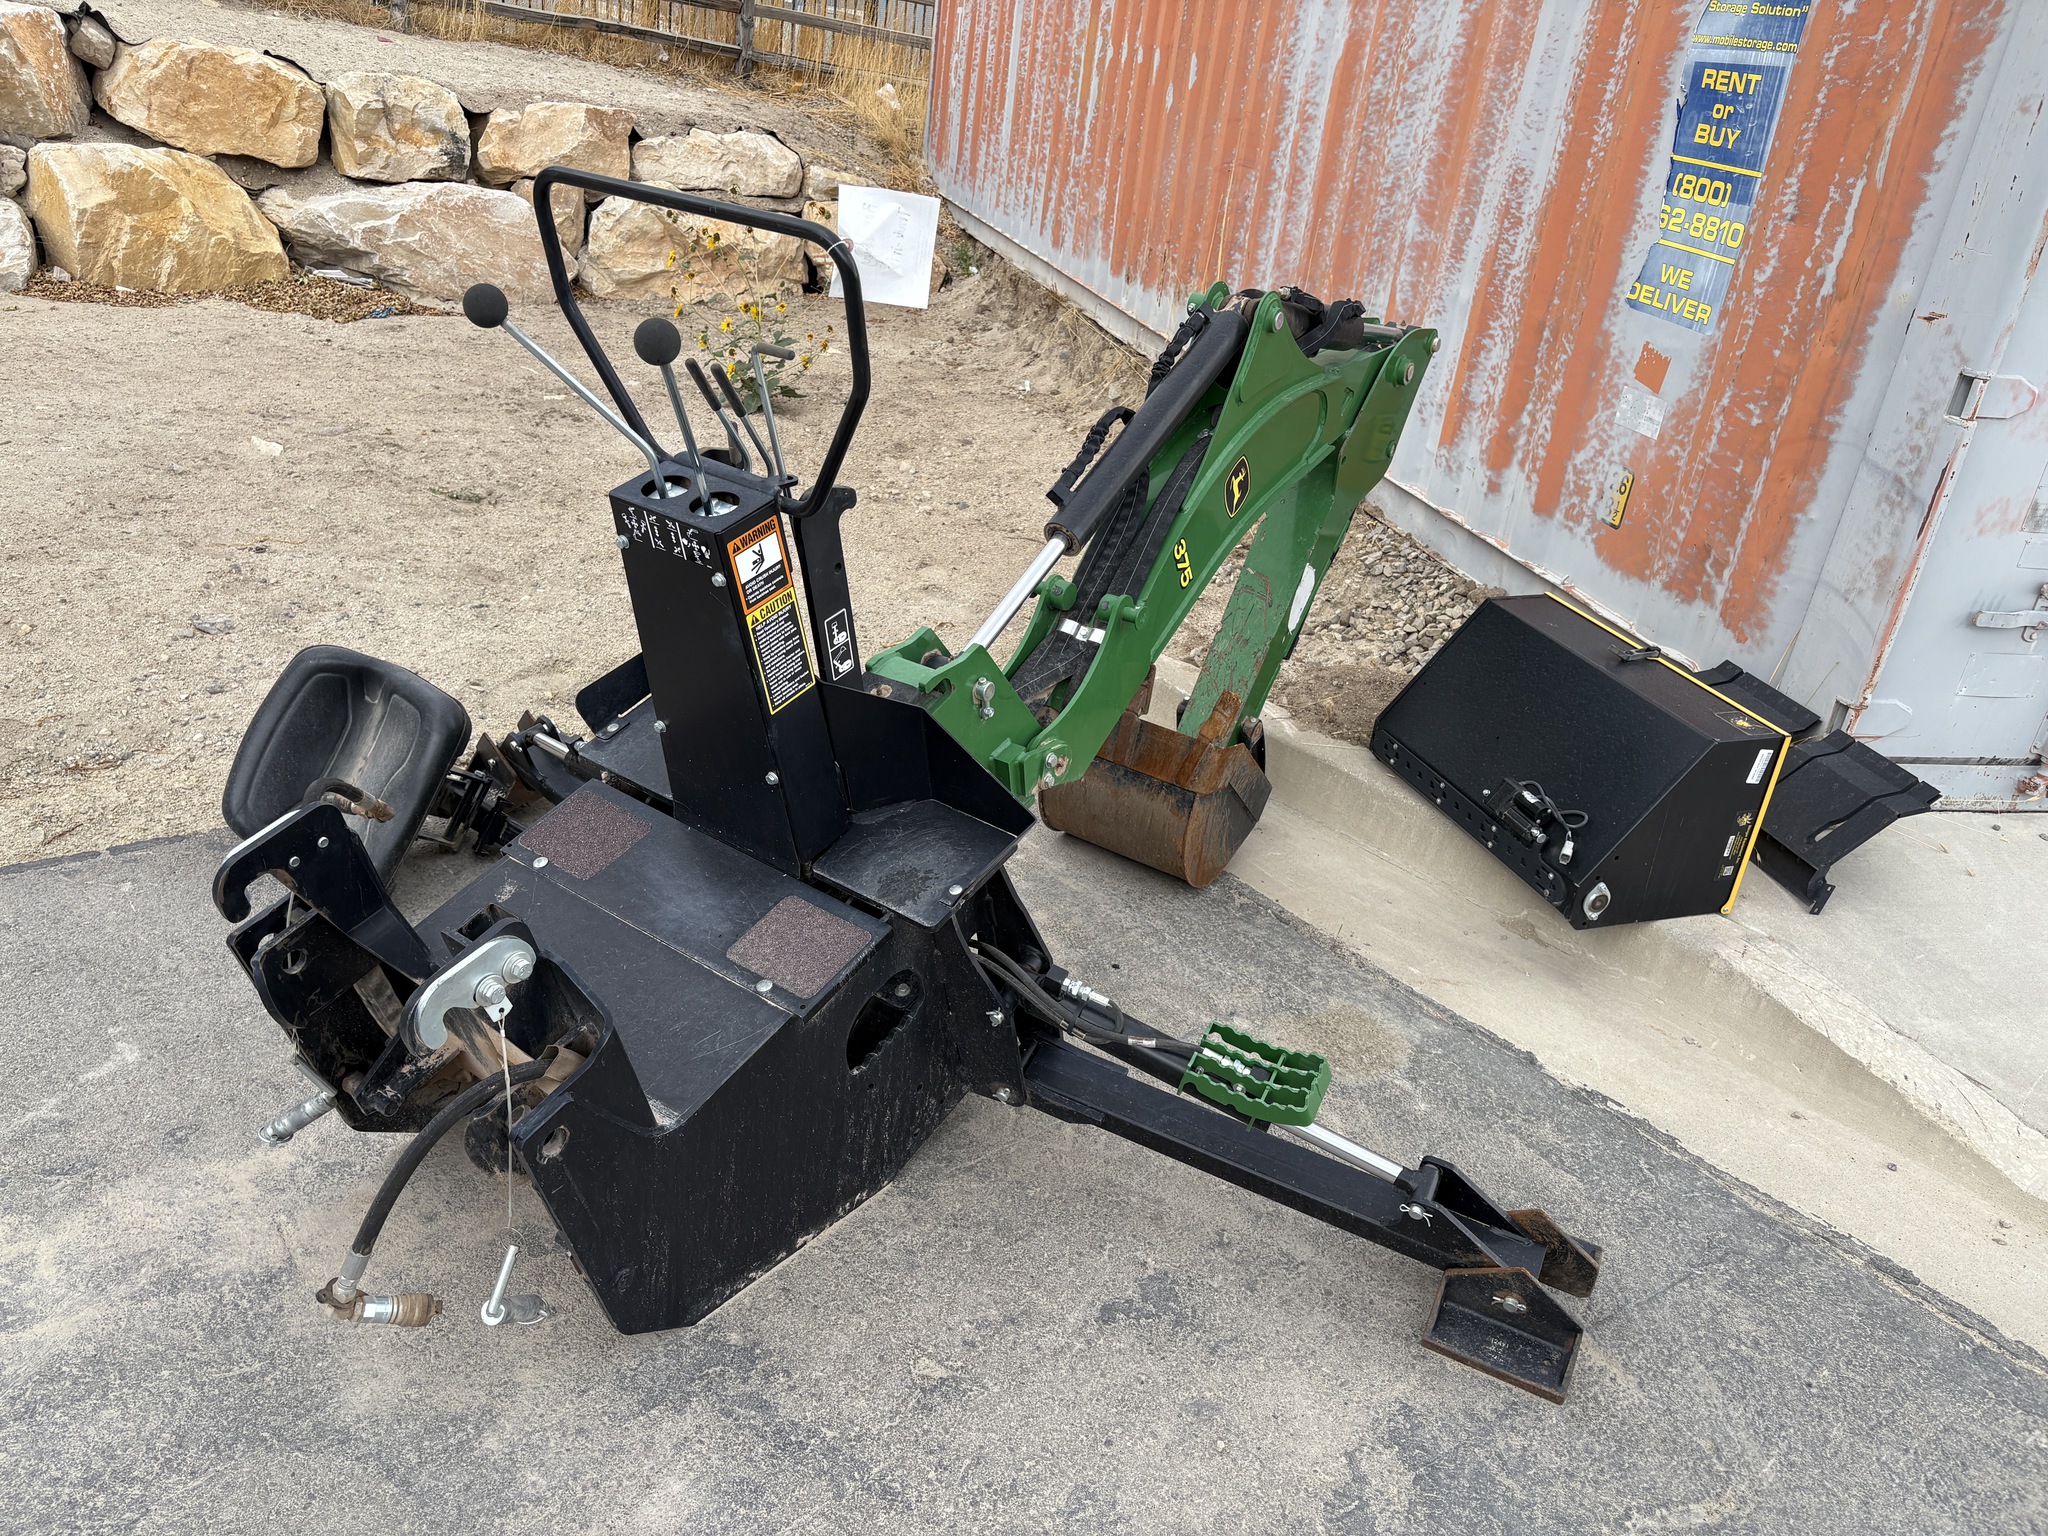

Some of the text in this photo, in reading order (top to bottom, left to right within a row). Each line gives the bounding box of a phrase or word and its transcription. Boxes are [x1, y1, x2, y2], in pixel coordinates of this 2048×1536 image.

[1708, 0, 1748, 16] Storage
[1692, 33, 1798, 52] www.mobilestorage.com
[1701, 68, 1762, 95] RENT
[1712, 103, 1734, 120] or
[1693, 123, 1742, 150] BUY
[1672, 172, 1733, 208] (800)
[1661, 263, 1694, 291] WE
[1626, 282, 1713, 326] DELIVER
[739, 519, 777, 548] WARNING
[1173, 538, 1194, 588] 375
[760, 590, 793, 619] CAUTION
